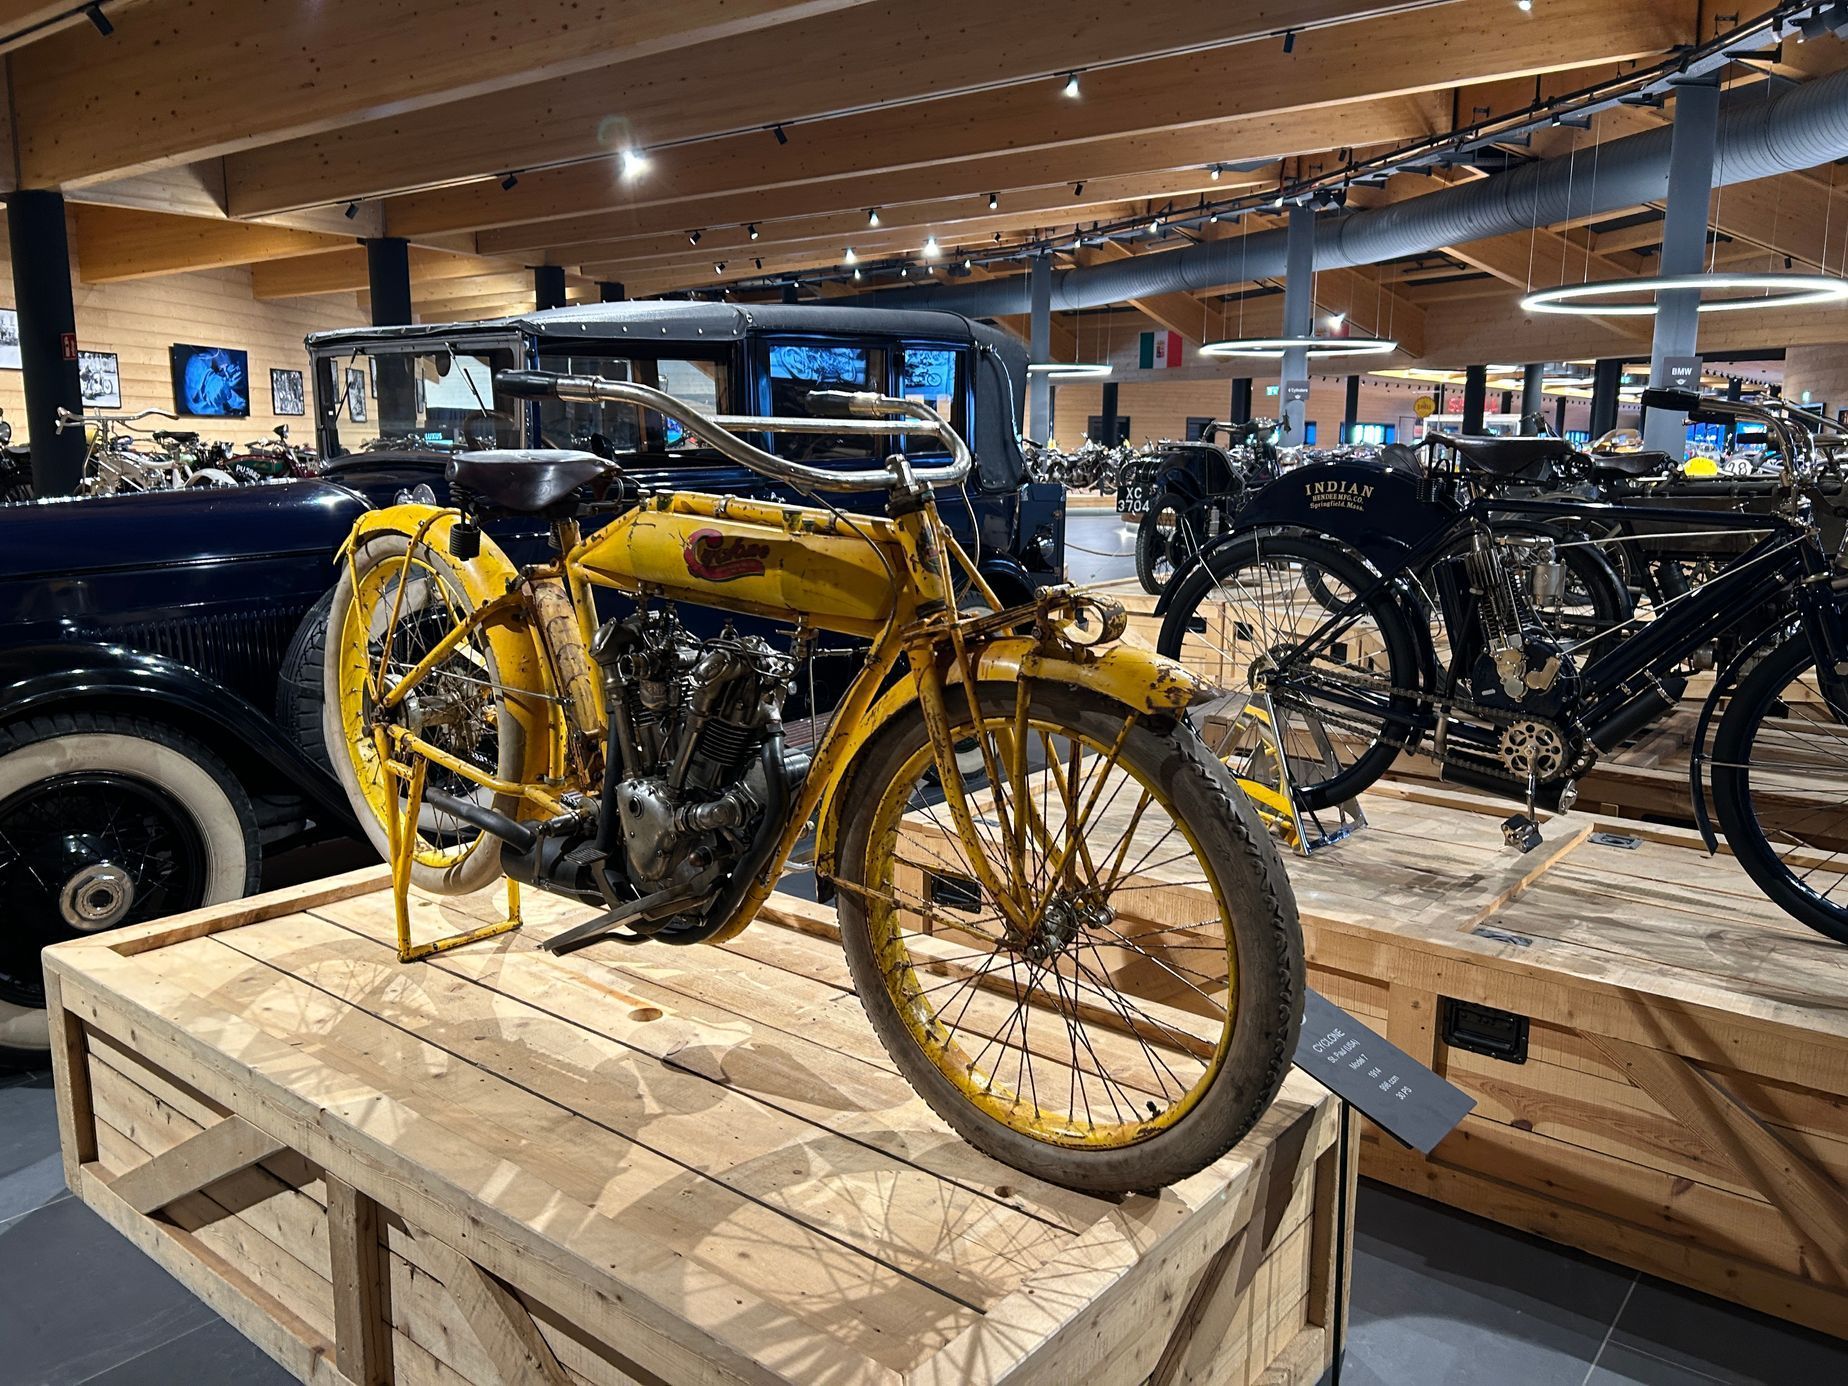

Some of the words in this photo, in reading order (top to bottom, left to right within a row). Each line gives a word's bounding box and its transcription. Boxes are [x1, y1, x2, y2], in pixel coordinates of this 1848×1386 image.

[1671, 367, 1692, 376] BMW
[1126, 486, 1142, 499] XC
[1305, 481, 1374, 498] INDIAN
[1312, 494, 1337, 502] HENDEE
[1117, 499, 1150, 512] 3704
[1312, 1028, 1345, 1053] CYCLONE
[1344, 1038, 1360, 1053] (USA)
[1368, 1066, 1382, 1079] 1914
[1401, 1086, 1412, 1096] PS
